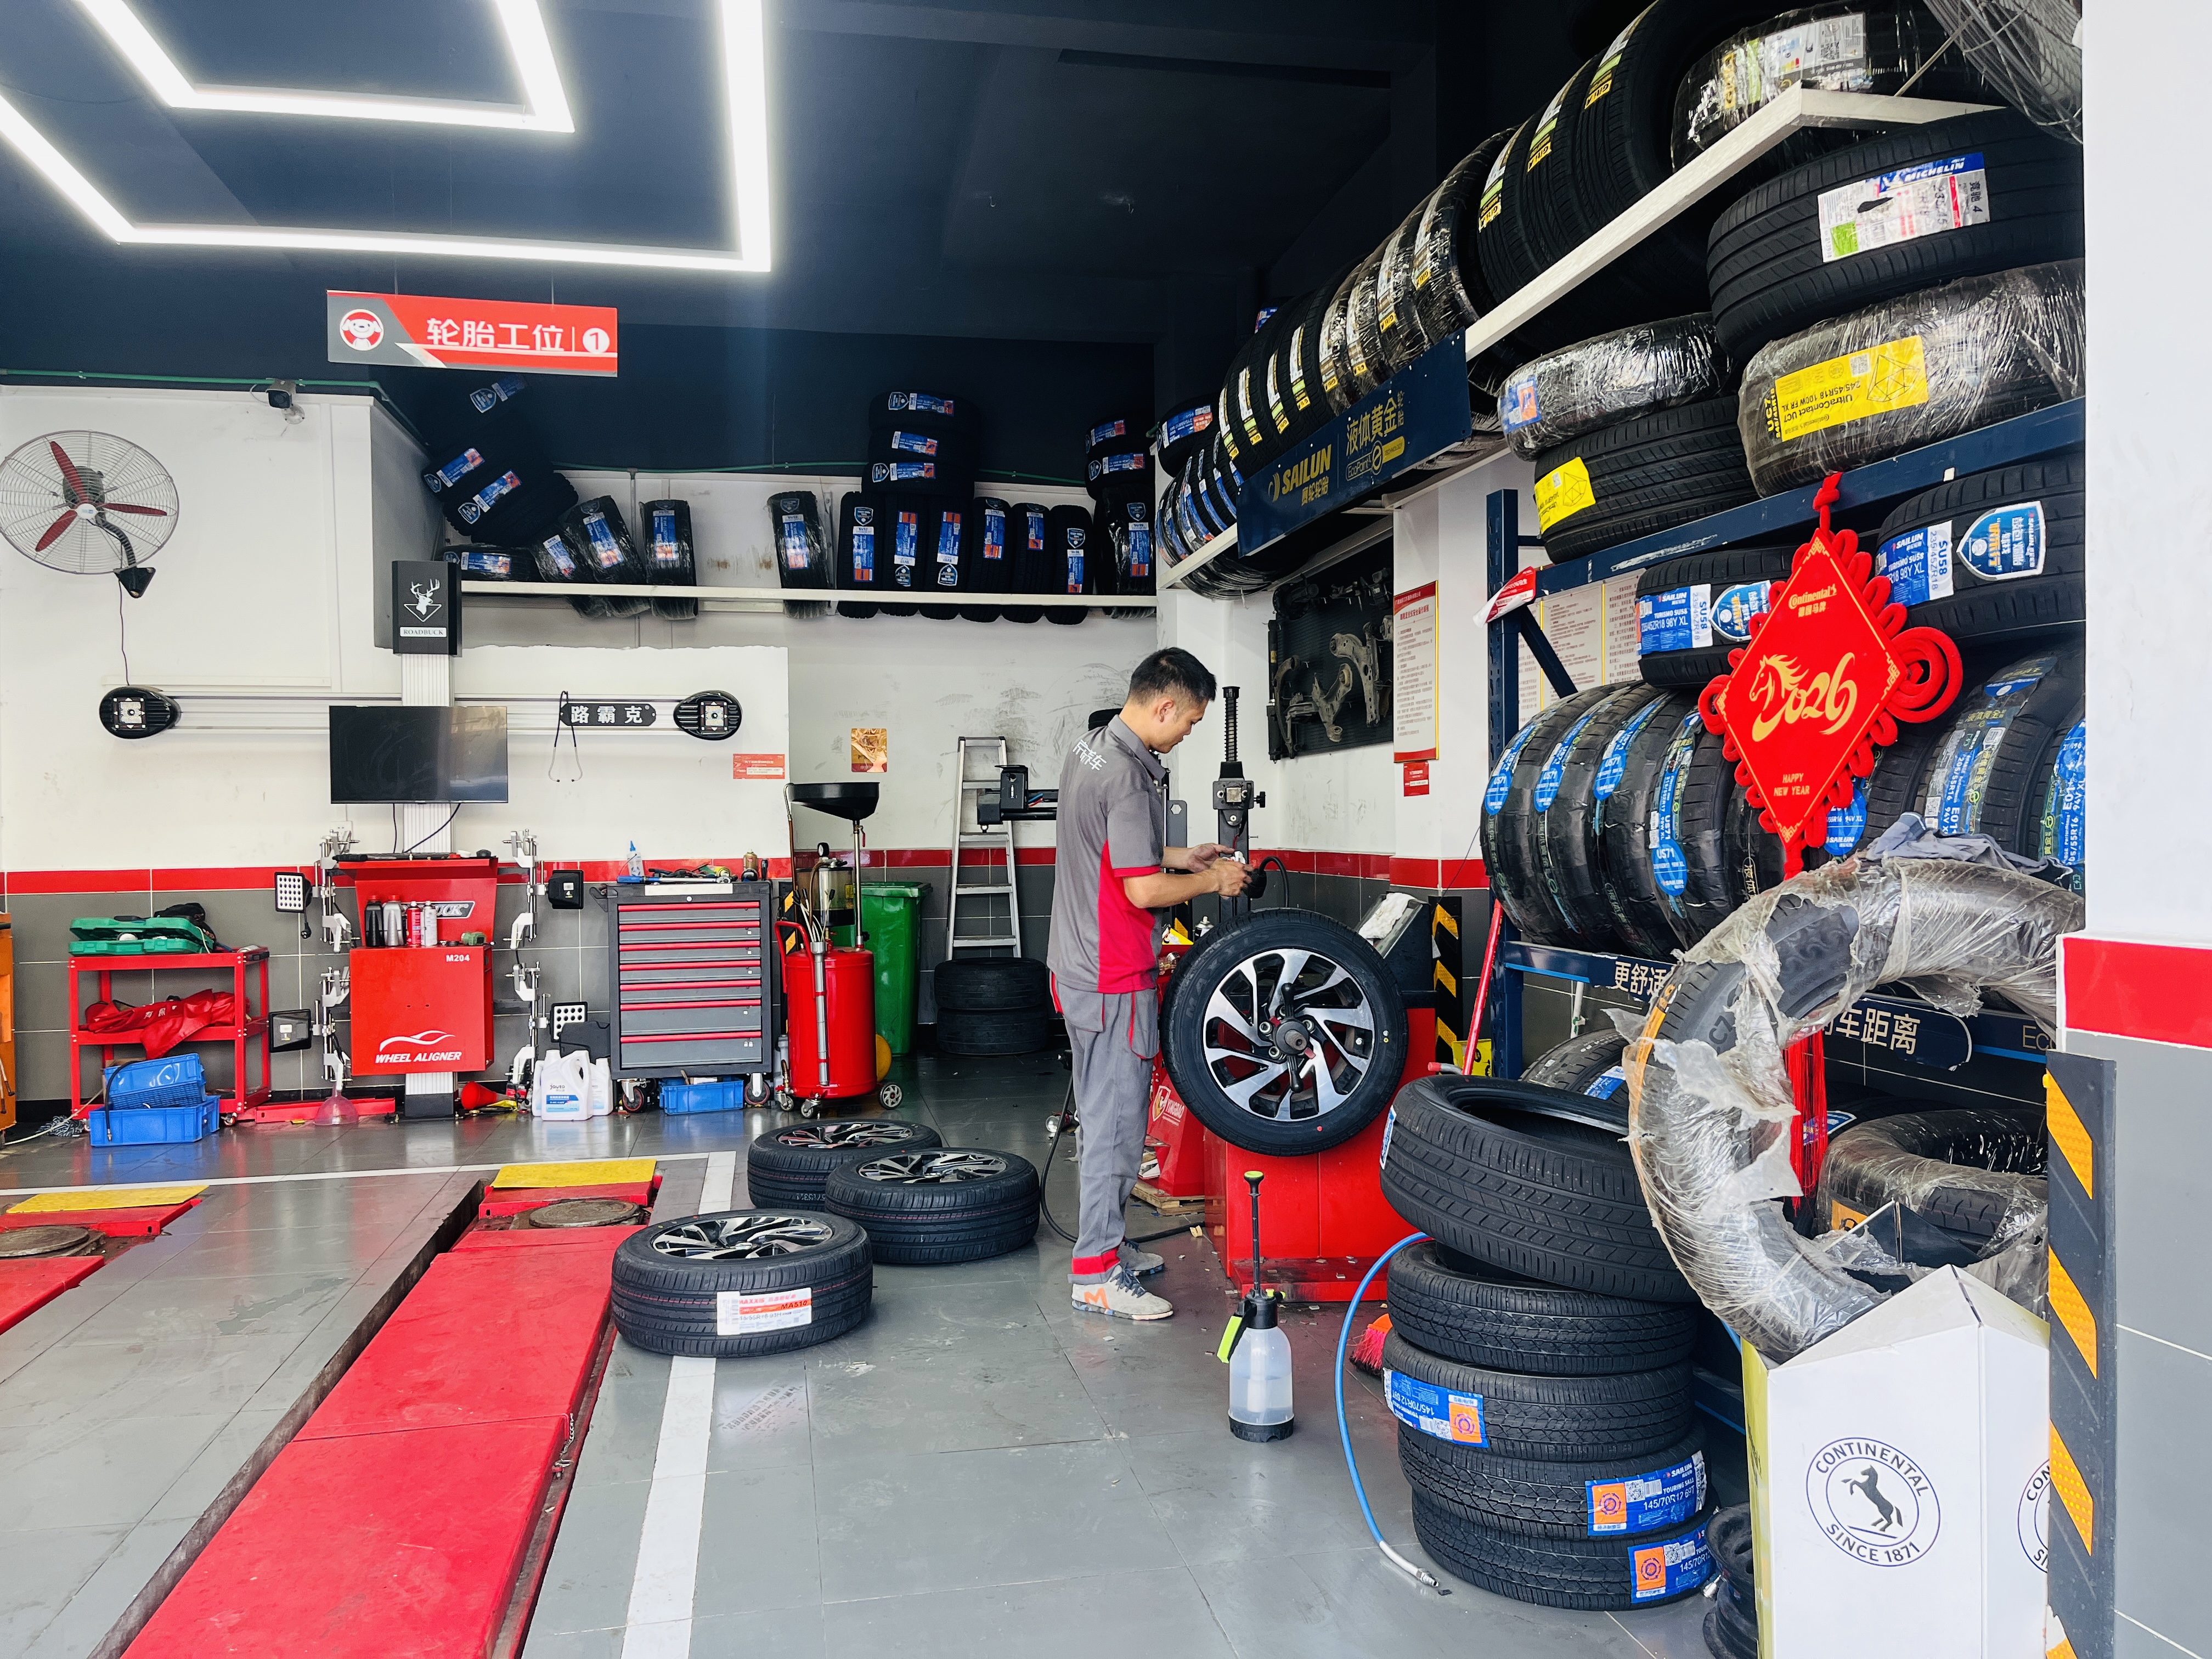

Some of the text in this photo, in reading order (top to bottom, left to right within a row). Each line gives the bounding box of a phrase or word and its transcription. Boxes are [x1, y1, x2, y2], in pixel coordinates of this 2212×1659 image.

[1904, 162, 1964, 182] MICHELIN
[426, 318, 565, 352] 轮胎工位
[1800, 393, 1819, 404] 100W
[1820, 381, 1861, 399] 245/45R18
[1764, 397, 1773, 432] UC7
[1784, 394, 1853, 423] UltraContact UC7
[1346, 397, 1398, 457] 液体黄金
[1282, 444, 1333, 495] SAILUN
[1896, 532, 1923, 549] SAILUN
[1888, 552, 1924, 572] TURISMO SU58
[1930, 531, 1939, 590] 235/45ZR18
[1938, 540, 1948, 575] SU58
[1914, 562, 1925, 575] XL
[1662, 591, 1687, 602] SAILUN
[1788, 586, 1832, 610] Continental
[1654, 610, 1673, 619] TURISMO
[1798, 601, 1826, 618] 德国马牌
[1666, 617, 1678, 628] 98Y
[1679, 616, 1689, 626] XL
[1749, 652, 1858, 742] 2026
[571, 705, 644, 724] 路霸克
[1605, 756, 1621, 768] US71
[1782, 772, 1804, 783] HAPPY
[1946, 757, 1965, 802] 205/55R16
[1773, 786, 1810, 797] NEW YEAR
[1943, 806, 1951, 824] 94V
[1656, 847, 1675, 859] US71
[445, 954, 470, 962] M204
[375, 1051, 462, 1064] WHEEL ALIGNER
[781, 1300, 808, 1309] MA510
[1401, 1395, 1435, 1416] 145/70R12
[1671, 1462, 1692, 1477] SAILUN
[1815, 1441, 1929, 1497] CONTINENTAL
[1663, 1481, 1685, 1495] TOURING
[1643, 1486, 1695, 1510] 145/70R12 69T
[1826, 1523, 1921, 1563] SINCE 1871
